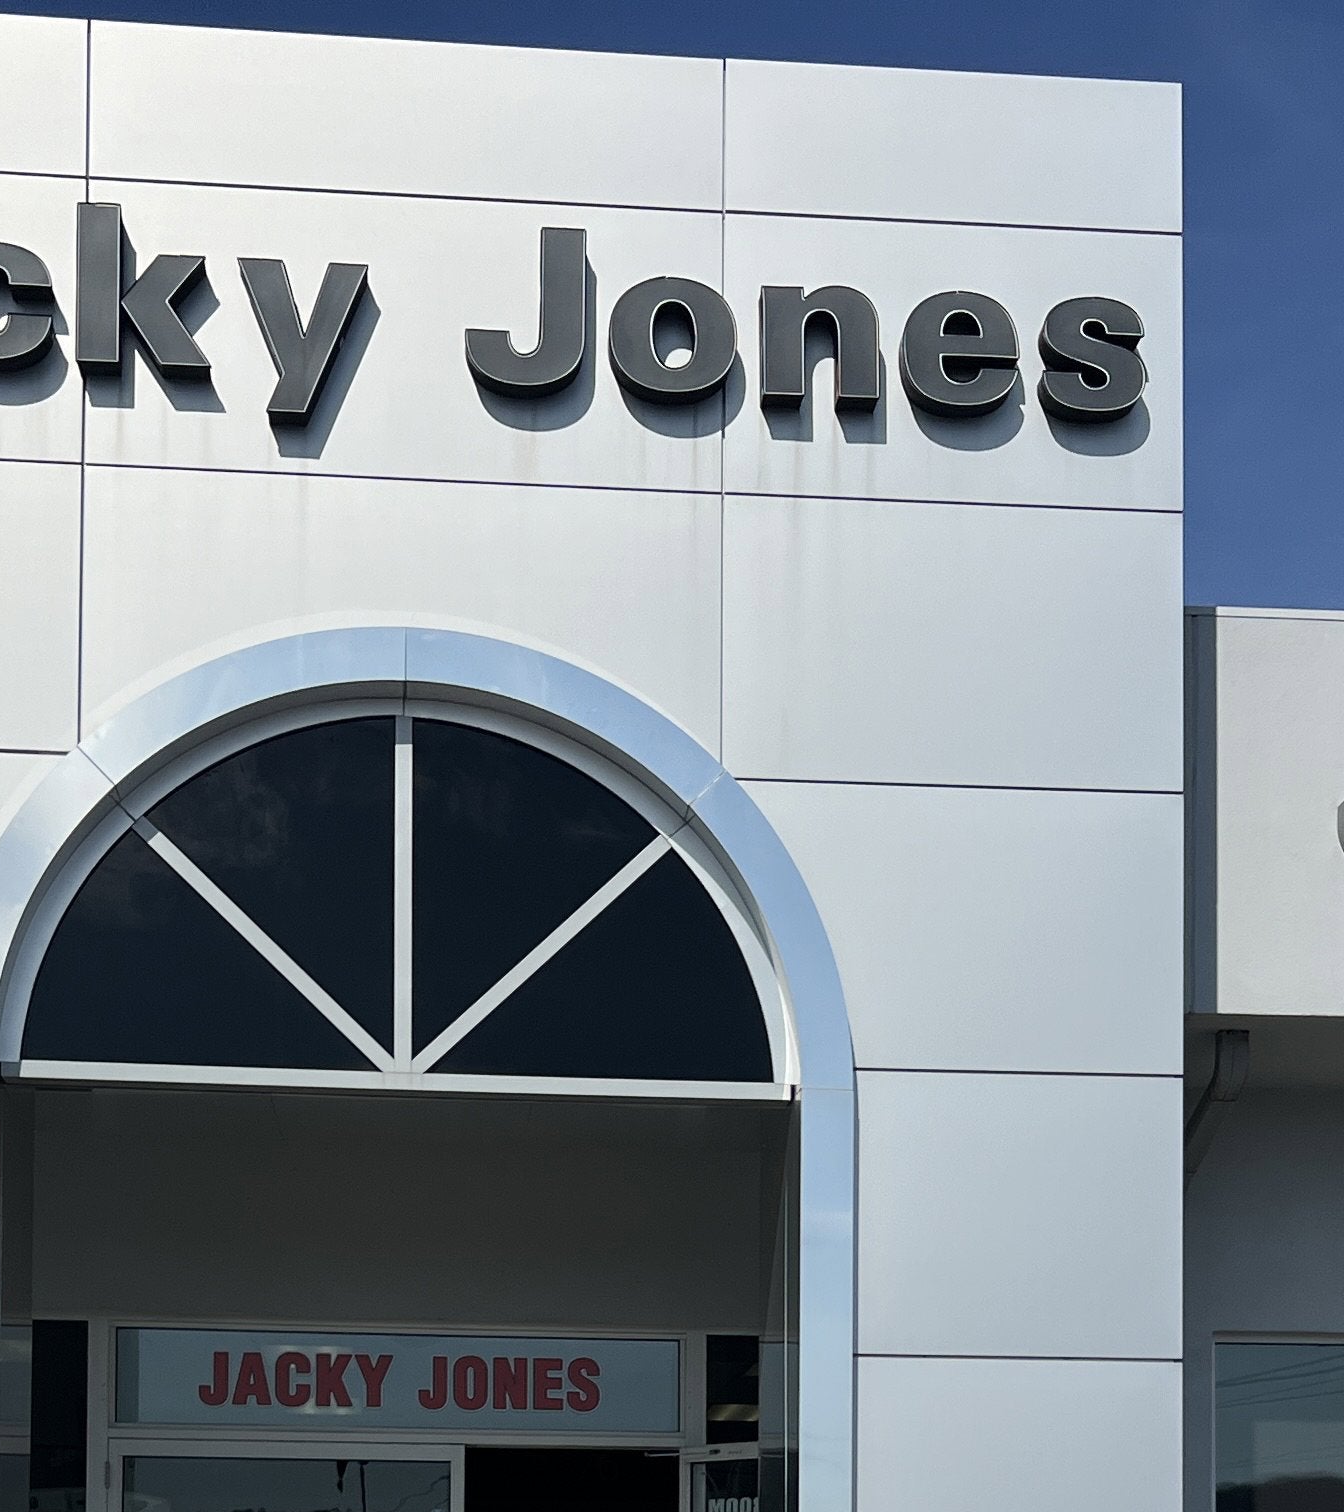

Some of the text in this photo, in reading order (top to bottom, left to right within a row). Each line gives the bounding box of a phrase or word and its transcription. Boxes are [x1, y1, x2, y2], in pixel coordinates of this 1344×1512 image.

[464, 226, 1148, 424] Jones
[198, 1351, 602, 1411] JACKY JONES
